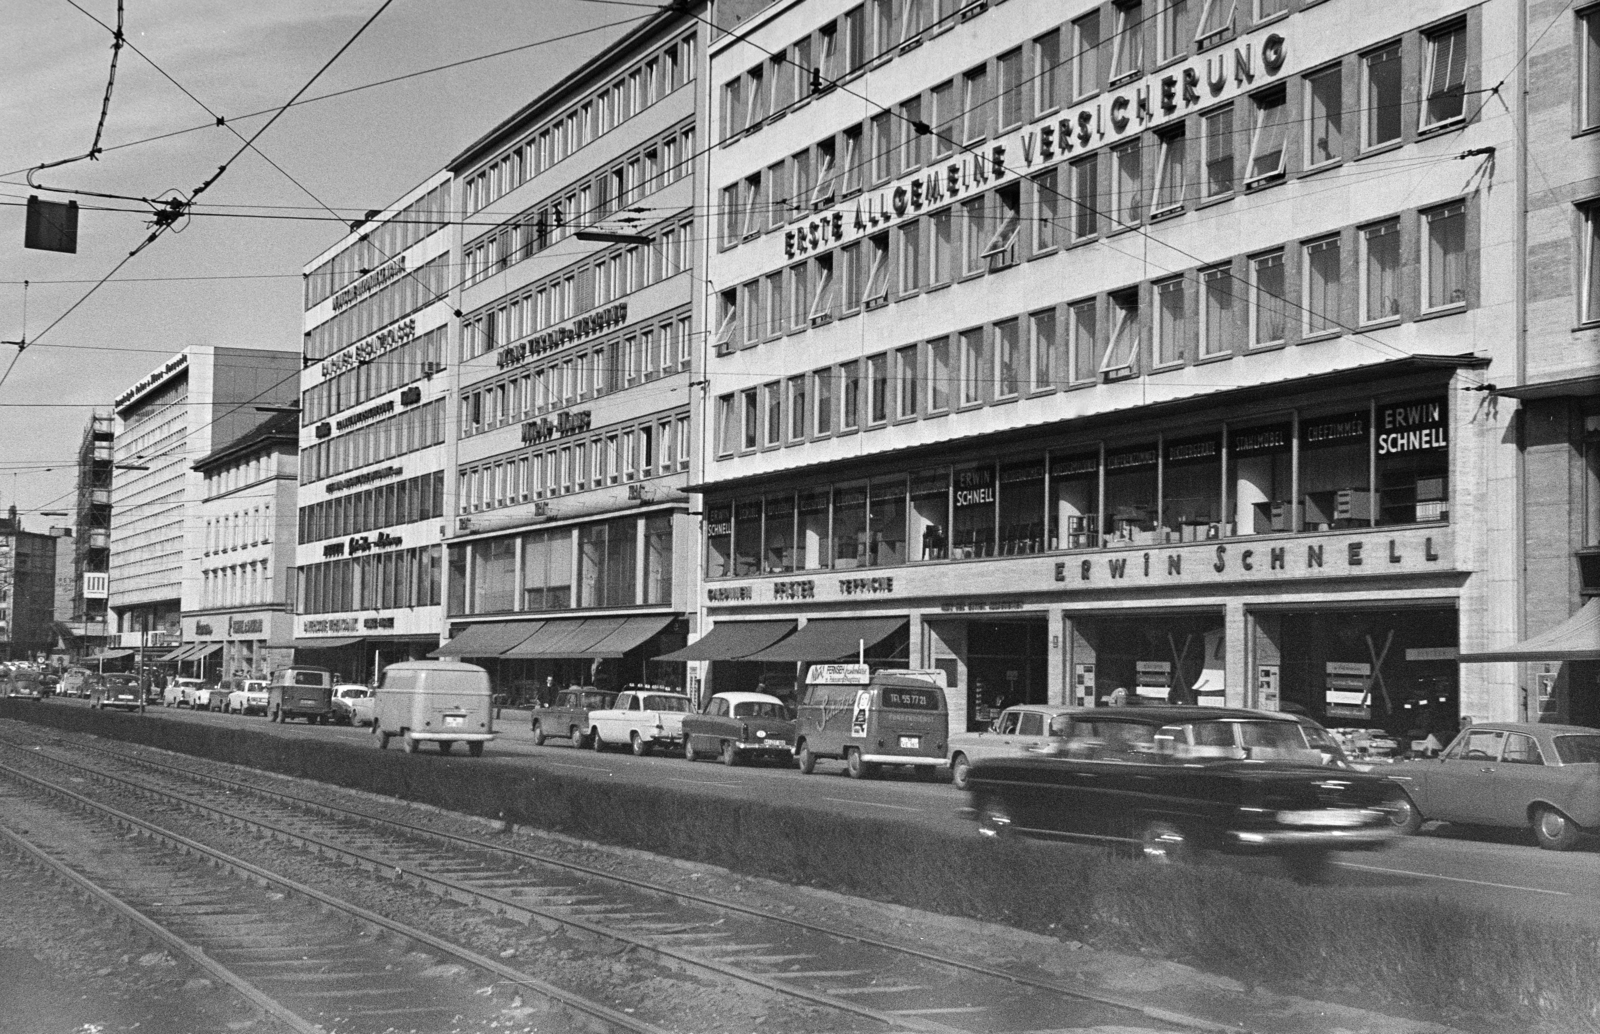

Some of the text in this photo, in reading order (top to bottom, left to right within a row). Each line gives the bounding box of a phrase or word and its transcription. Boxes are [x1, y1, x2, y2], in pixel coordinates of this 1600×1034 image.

[785, 33, 1287, 259] ERSTE ALLGEMEINE VERSICHERUNG
[1385, 403, 1439, 429] ERWIN
[1308, 421, 1363, 441] CHEFZIMMER
[1378, 427, 1447, 454] SCHNELL
[960, 470, 990, 487] ERWIN
[956, 488, 994, 506] SCHNELL
[708, 522, 731, 536] SCHNELL
[1213, 537, 1438, 573] SCHNELL
[839, 576, 893, 595] TEPPICHE
